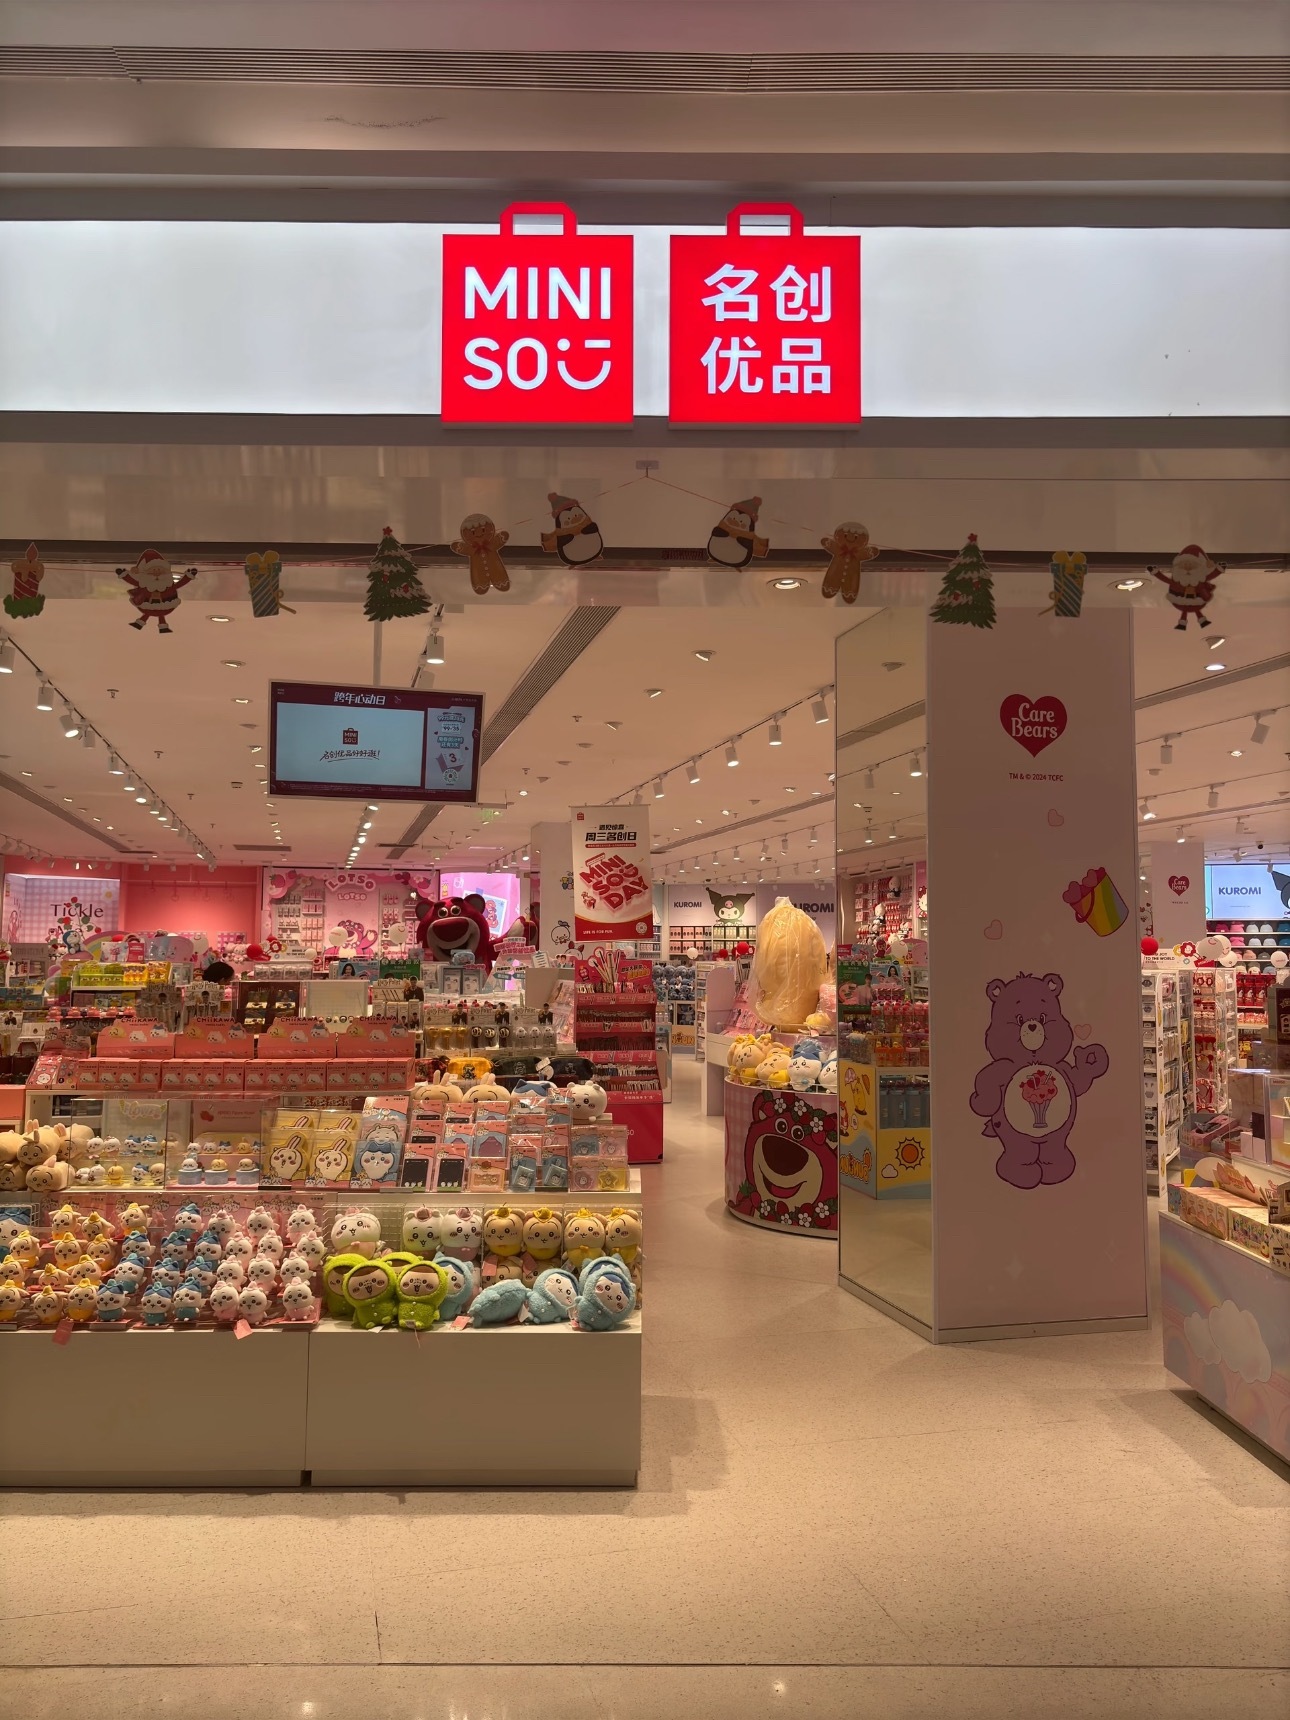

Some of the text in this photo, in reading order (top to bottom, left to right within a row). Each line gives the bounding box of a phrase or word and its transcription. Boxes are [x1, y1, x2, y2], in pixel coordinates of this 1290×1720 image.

[464, 266, 611, 320] MINI
[701, 263, 832, 322] 名创
[700, 335, 832, 394] 优品
[333, 691, 386, 705] 跨年心动日
[1019, 702, 1055, 722] Care
[1011, 717, 1058, 738] Bears
[449, 753, 457, 763] 3
[585, 831, 637, 841] 周三名创日
[579, 854, 626, 883] MINI
[327, 873, 375, 890] LOTSO
[338, 892, 367, 900] LOTSO
[603, 875, 649, 909] DAY
[1218, 887, 1262, 895] KUROMI
[50, 903, 104, 918] Tickle
[792, 902, 835, 913] UROMI
